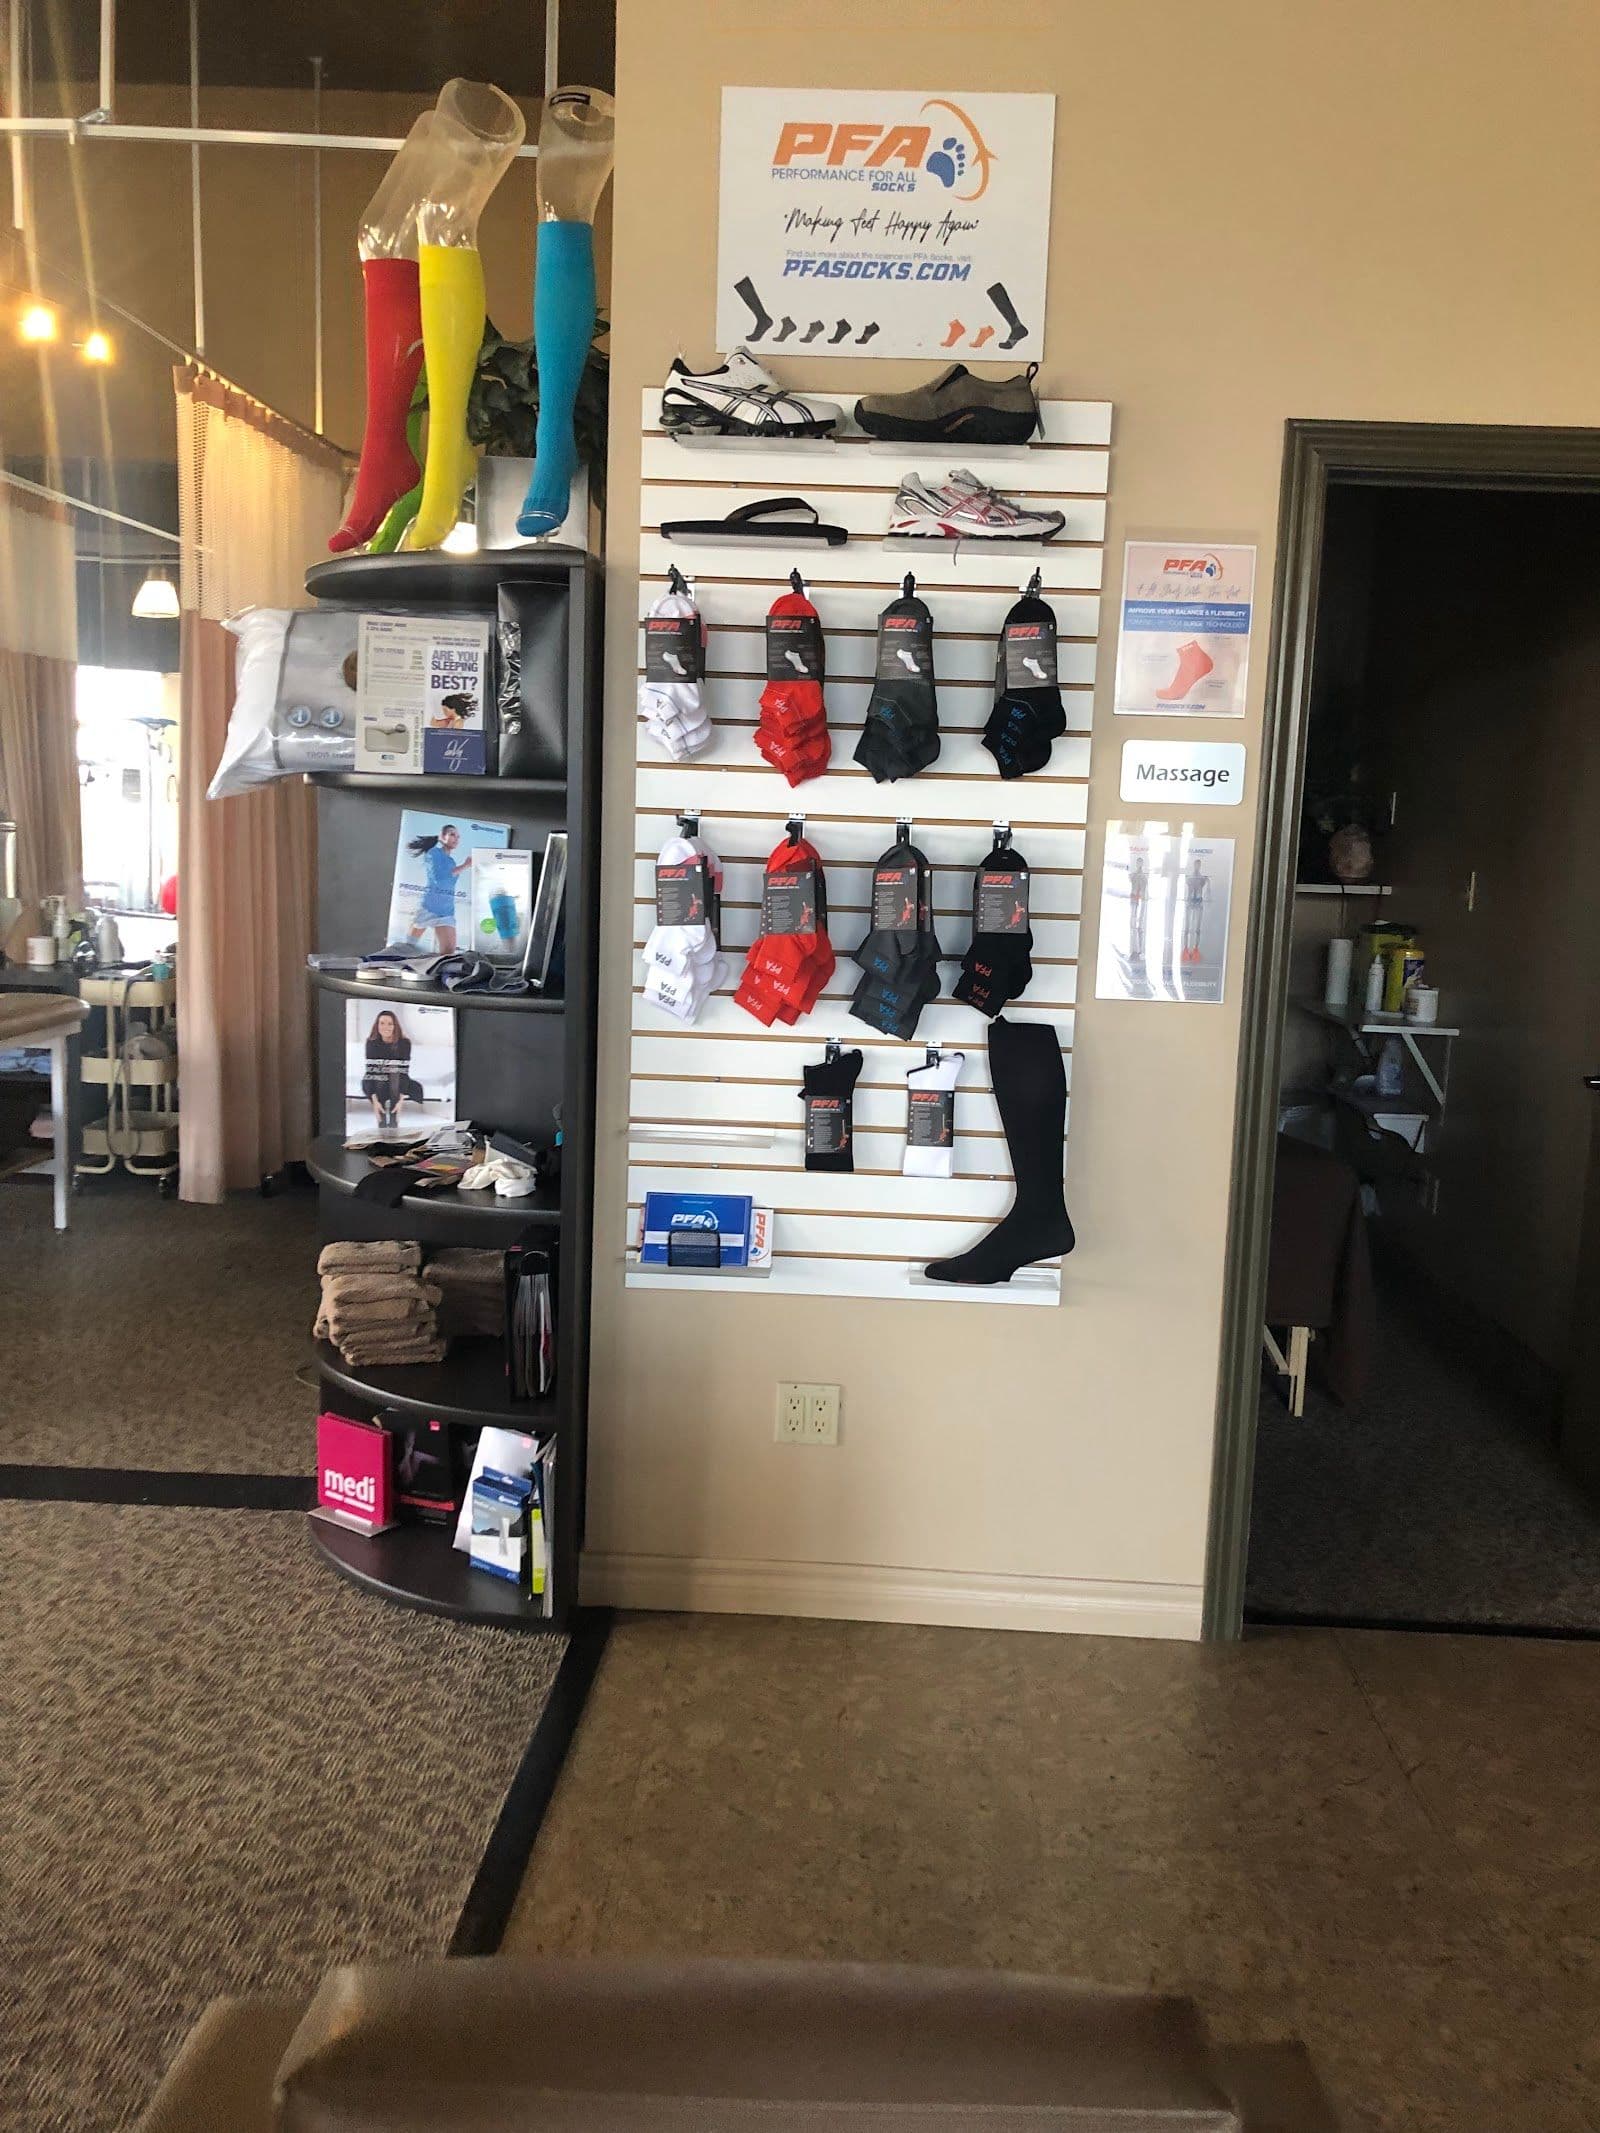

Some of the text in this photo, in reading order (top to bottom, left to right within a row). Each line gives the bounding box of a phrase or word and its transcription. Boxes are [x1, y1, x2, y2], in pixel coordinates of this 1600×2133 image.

[772, 122, 932, 168] PFA
[771, 168, 918, 183] PERFORMANCE FOR ALL
[870, 182, 916, 193] SOCKS
[885, 211, 932, 243] Happy
[783, 259, 971, 282] PFASOCKS.COM
[1163, 559, 1207, 571] PFA
[771, 620, 802, 629] PFA
[885, 617, 917, 628] PFA
[1008, 627, 1040, 637] PFA
[431, 649, 479, 662] ARE YOU
[431, 660, 479, 672] SLEEPING
[431, 674, 478, 690] BEST?
[1136, 763, 1230, 788] Massage
[658, 868, 687, 877] PFA
[875, 872, 903, 882] PFA
[767, 876, 798, 886] PFA
[982, 875, 1013, 885] PFA
[655, 951, 672, 967] PFA
[766, 960, 783, 975] PFA
[975, 963, 992, 977] PFA
[661, 981, 677, 996] PFA
[774, 980, 791, 995] PFA
[973, 984, 990, 999] PFA
[658, 992, 677, 1007] PFA
[747, 995, 763, 1011] PFA
[811, 1099, 840, 1108] PFA
[912, 1093, 939, 1102] PFA
[671, 1213, 705, 1226] PFA
[755, 1213, 767, 1248] PFA
[324, 1468, 376, 1504] medi
